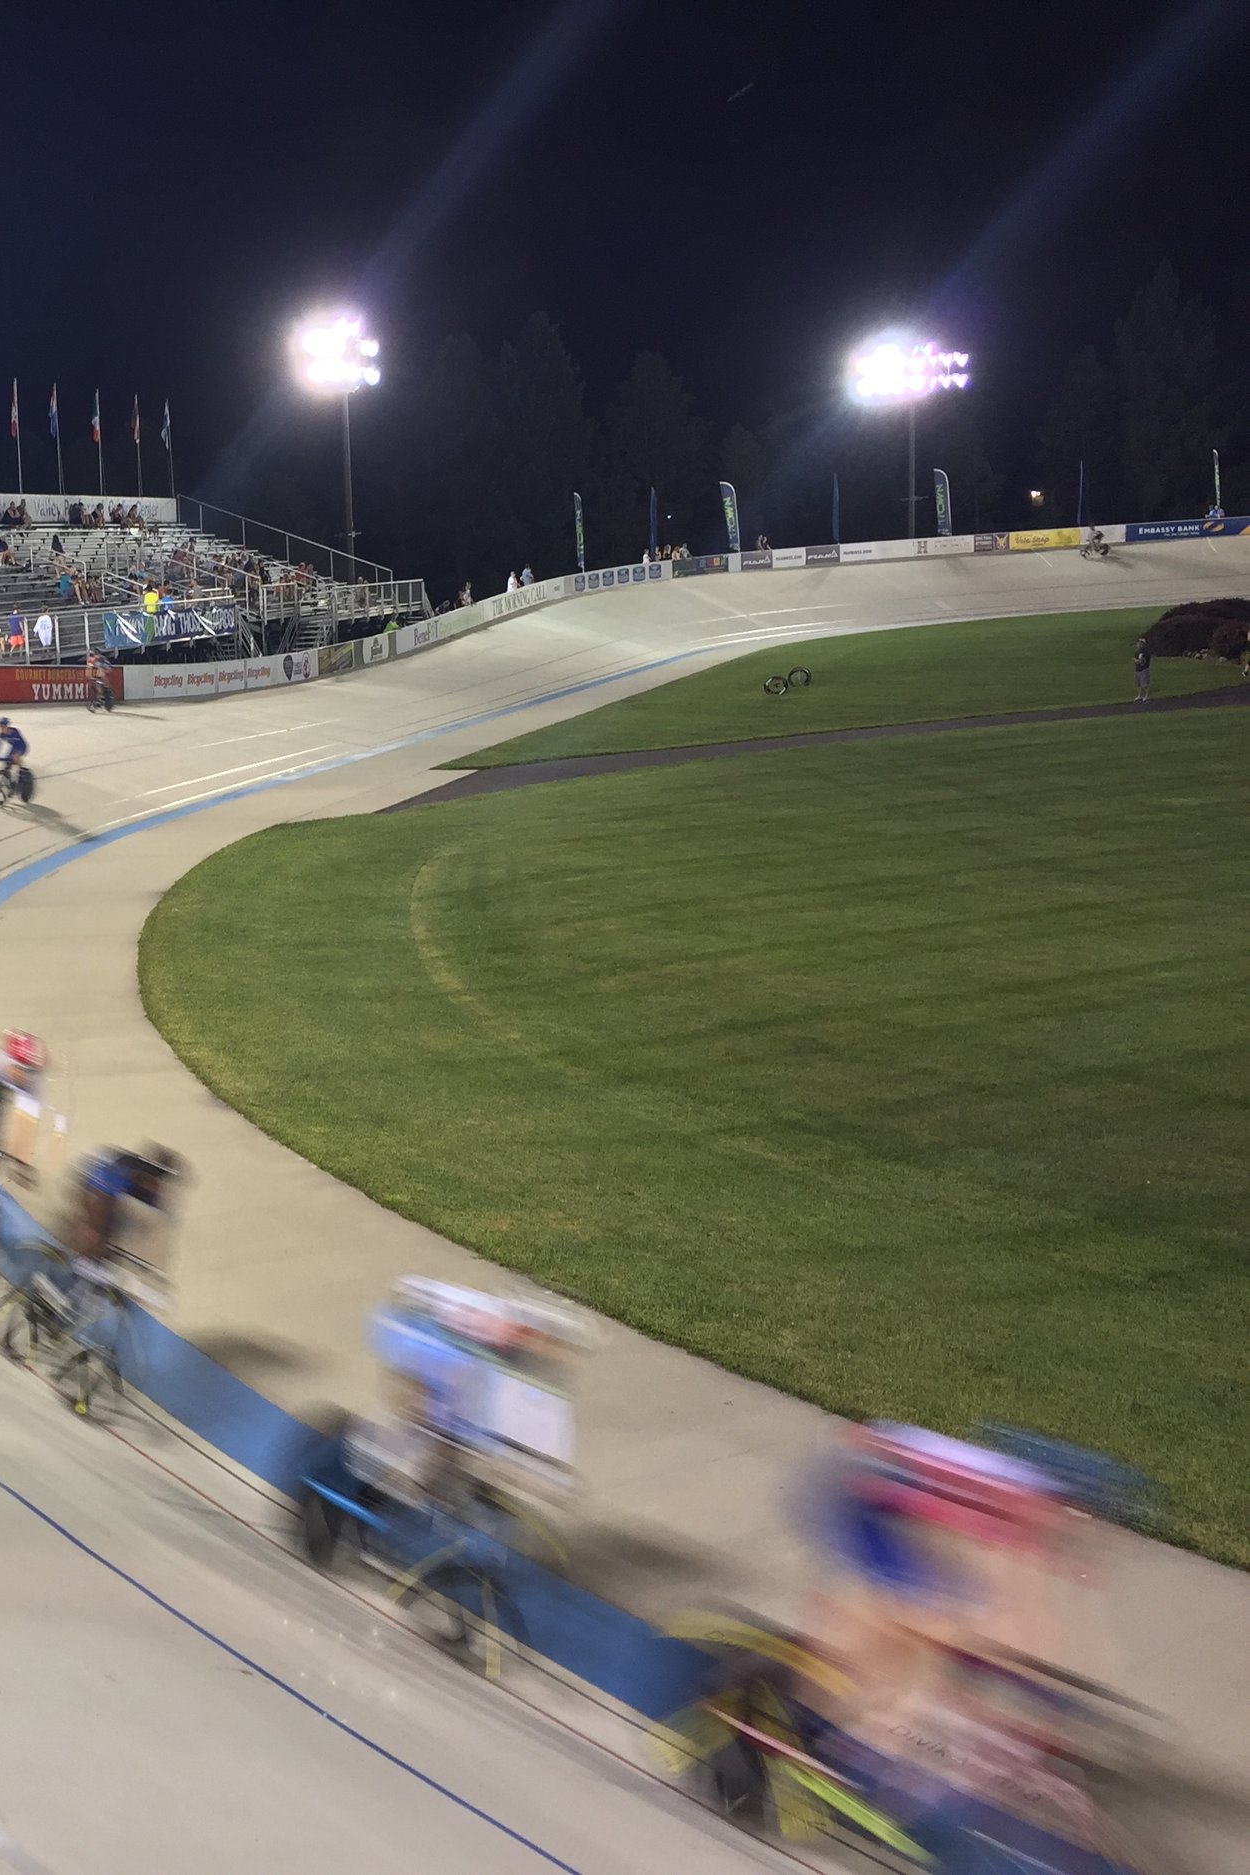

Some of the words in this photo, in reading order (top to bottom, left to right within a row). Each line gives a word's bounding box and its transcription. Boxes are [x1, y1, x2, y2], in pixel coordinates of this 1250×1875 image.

[1139, 526, 1175, 534] EMBASSY
[492, 597, 504, 617] THE
[503, 589, 530, 612] MORNING
[530, 584, 548, 602] CALL
[15, 668, 47, 681] GOURMET
[154, 674, 183, 688] Bicycling
[187, 672, 215, 687] Bicycling
[218, 669, 244, 684] Bicycling
